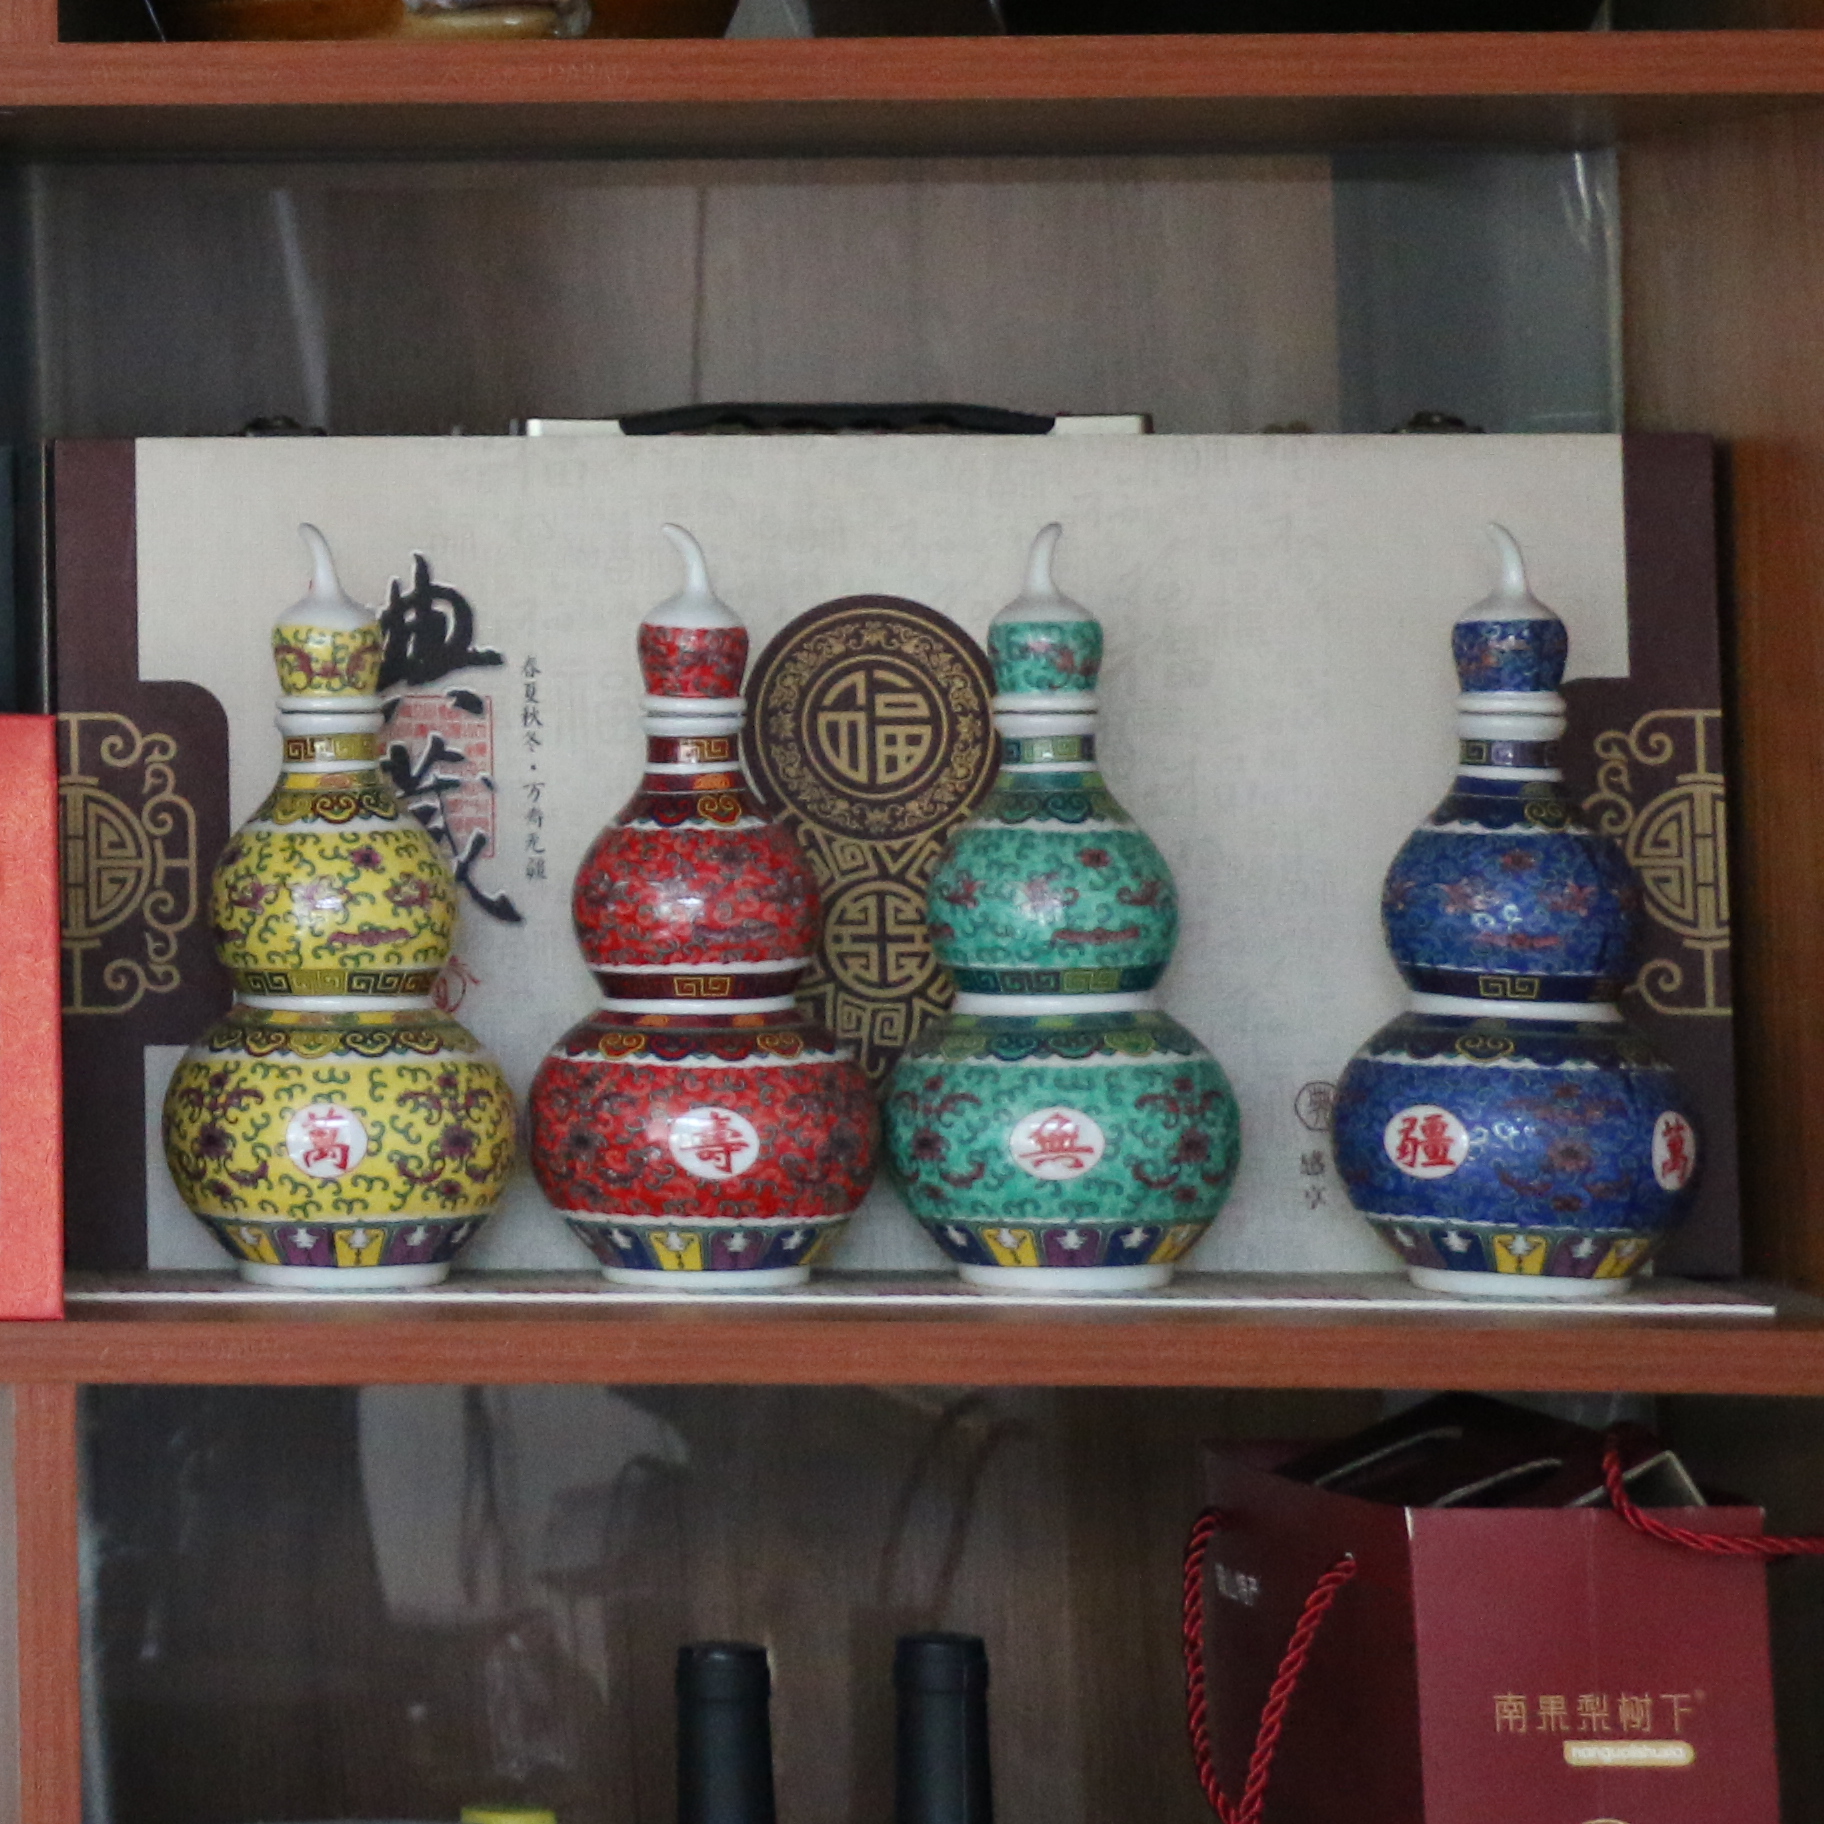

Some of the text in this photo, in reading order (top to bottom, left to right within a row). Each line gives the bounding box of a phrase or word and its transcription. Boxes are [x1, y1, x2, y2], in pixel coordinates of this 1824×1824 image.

[816, 669, 933, 785] 福
[303, 1107, 350, 1171] 萬
[680, 1111, 751, 1175] 壽
[1395, 1114, 1456, 1169] 疆
[1493, 1692, 1693, 1733] 南果梨树下
